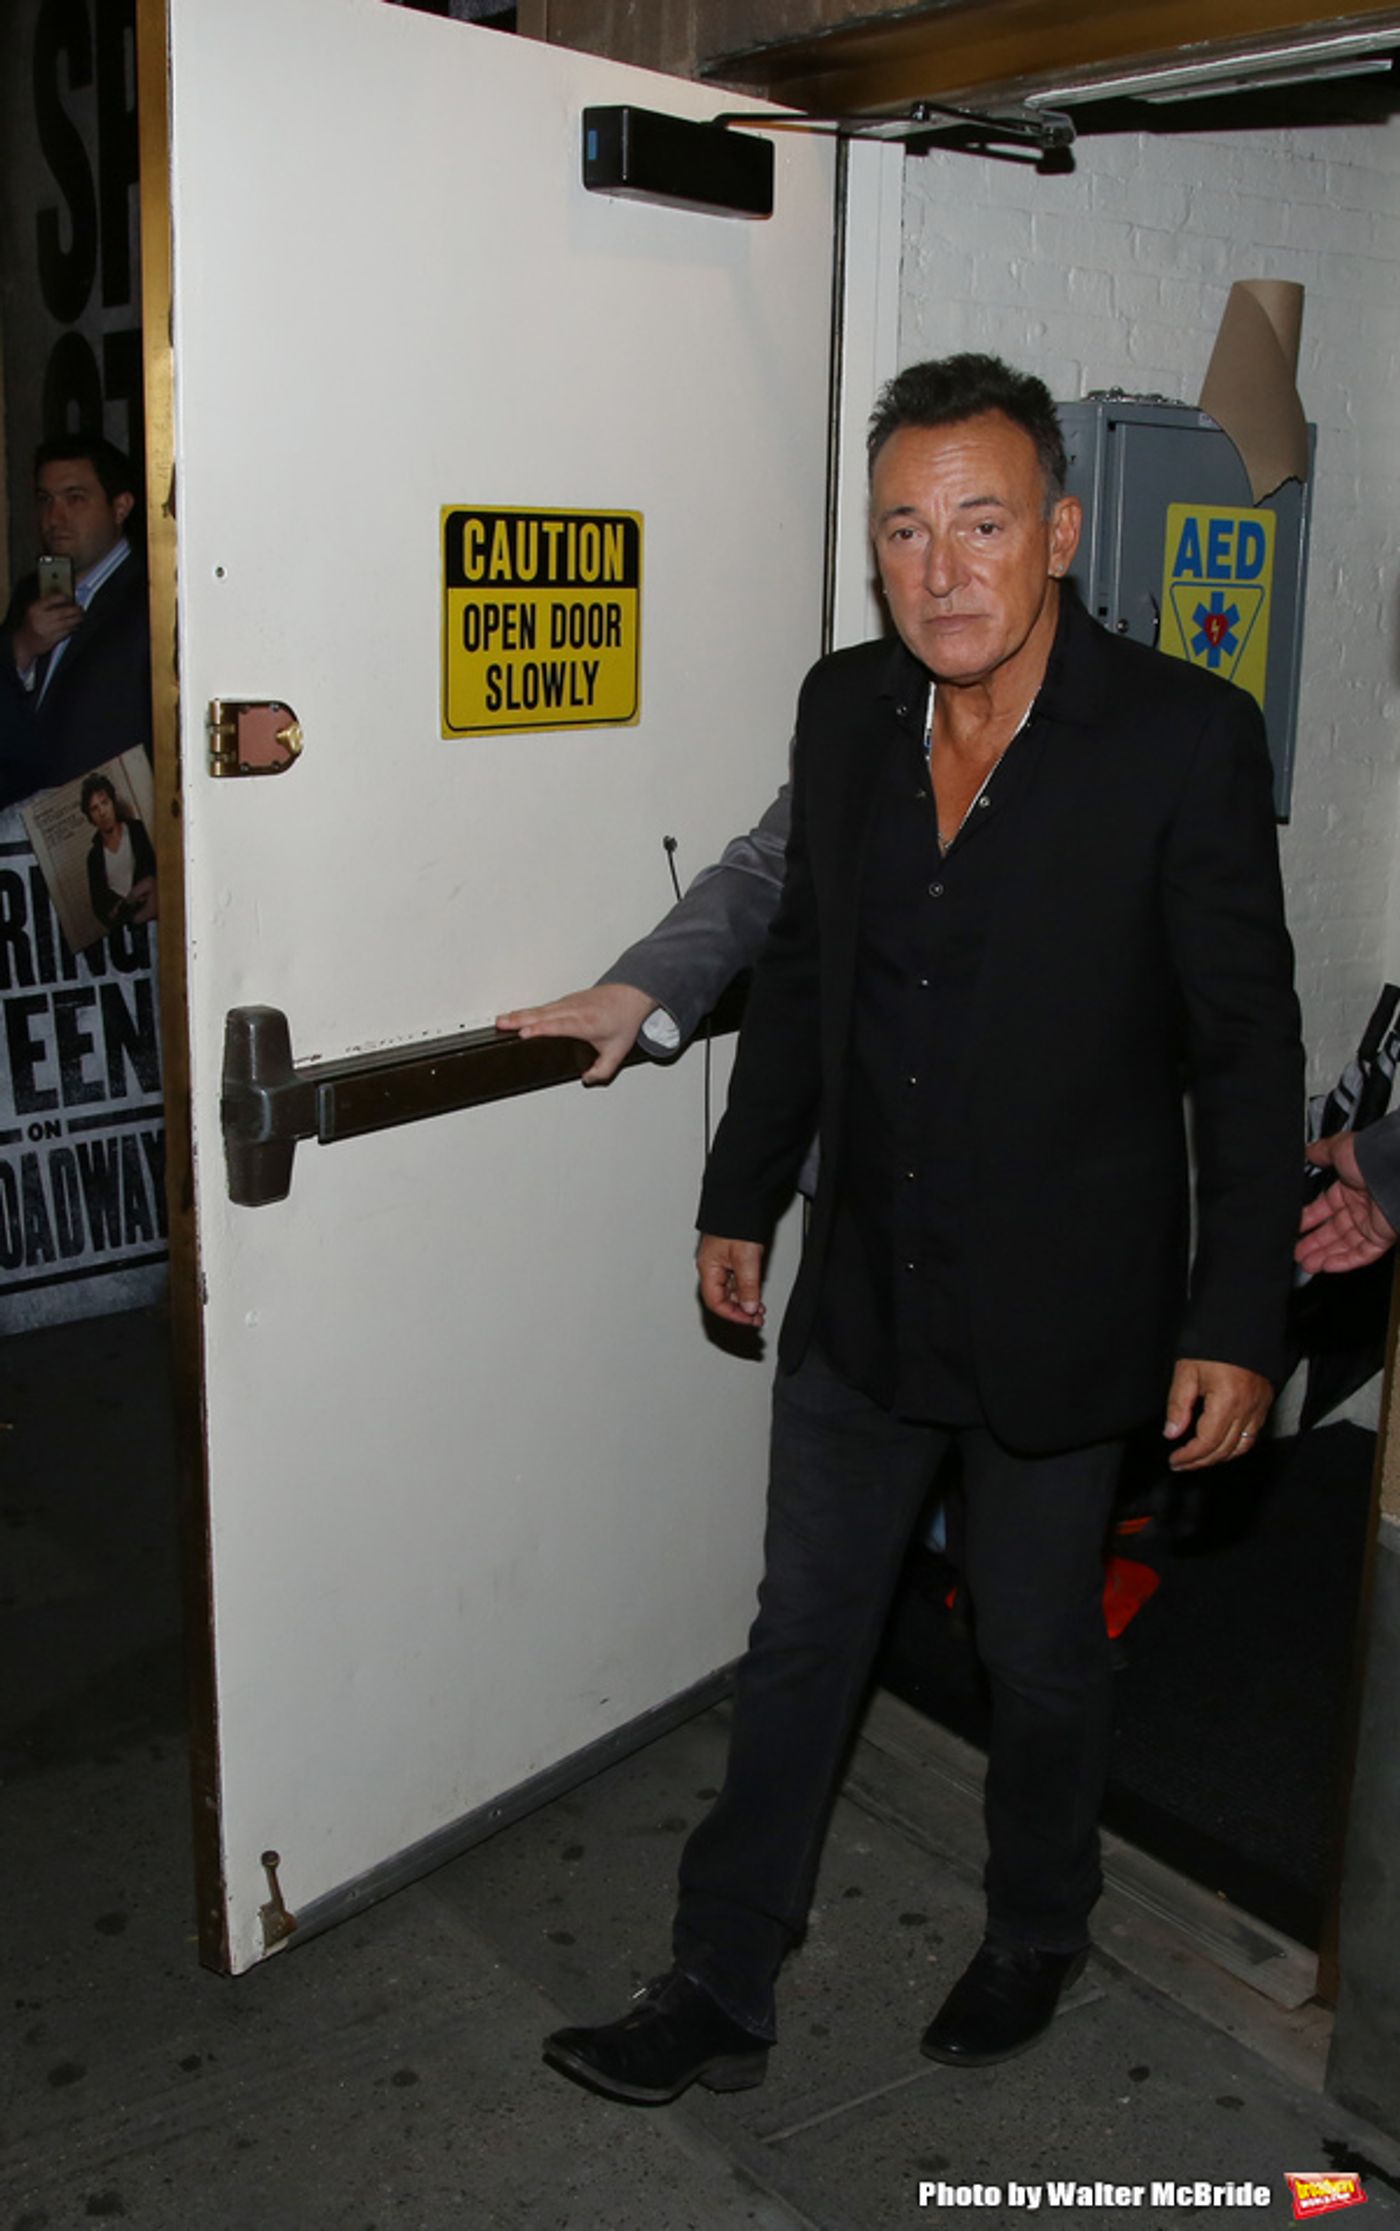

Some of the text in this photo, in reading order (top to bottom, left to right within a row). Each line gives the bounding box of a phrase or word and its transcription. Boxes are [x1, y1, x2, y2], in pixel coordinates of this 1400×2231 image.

[463, 518, 624, 581] CAUTION
[1172, 518, 1266, 580] AED
[463, 602, 622, 652] OPEN DOOR
[486, 660, 600, 711] SLOWLY
[6, 978, 161, 1115] EEN
[28, 1119, 62, 1141] ON
